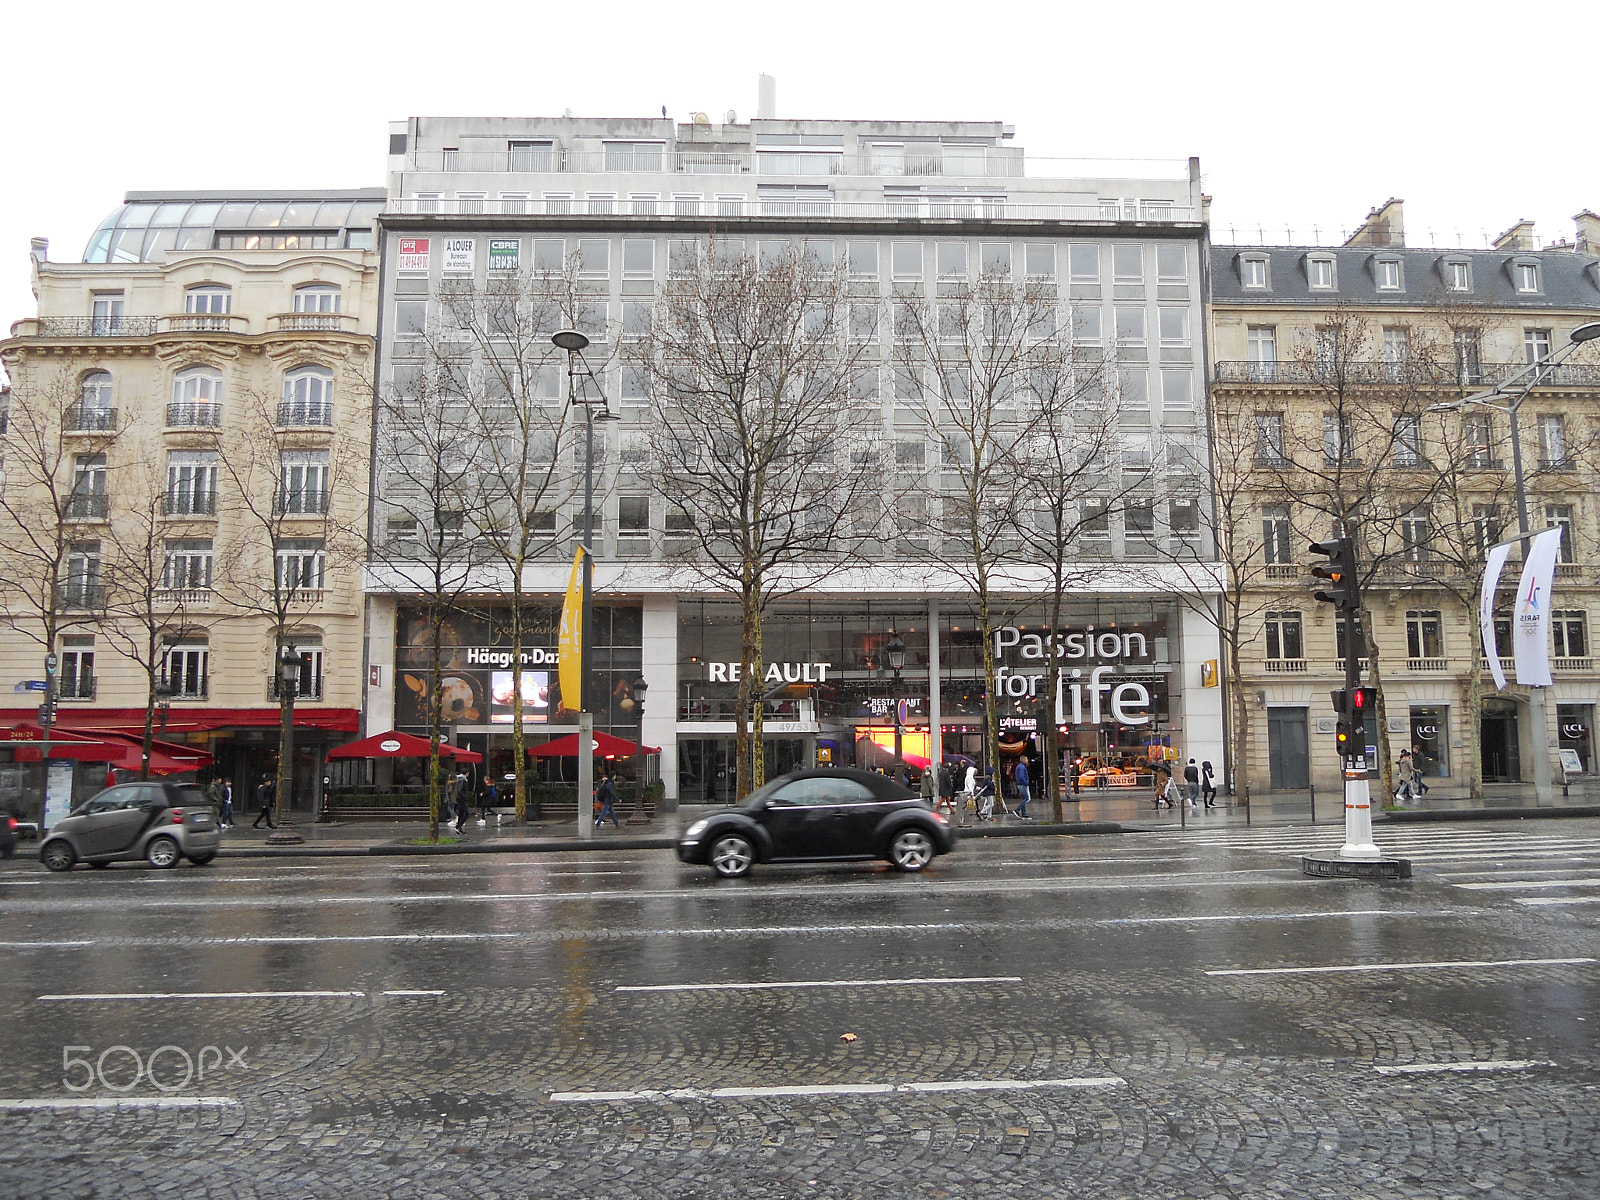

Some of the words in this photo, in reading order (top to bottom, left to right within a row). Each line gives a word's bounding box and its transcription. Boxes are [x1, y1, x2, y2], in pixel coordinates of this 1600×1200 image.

[446, 240, 452, 251] A
[453, 240, 473, 251] LOUER
[491, 241, 518, 249] CBRE
[994, 625, 1148, 659] Passion
[709, 662, 831, 682] REAULT
[994, 666, 1043, 697] for
[1055, 666, 1150, 725] life
[871, 698, 921, 706] RESTAANT
[999, 717, 1037, 728] L'ATELIER
[1419, 725, 1439, 733] LCL
